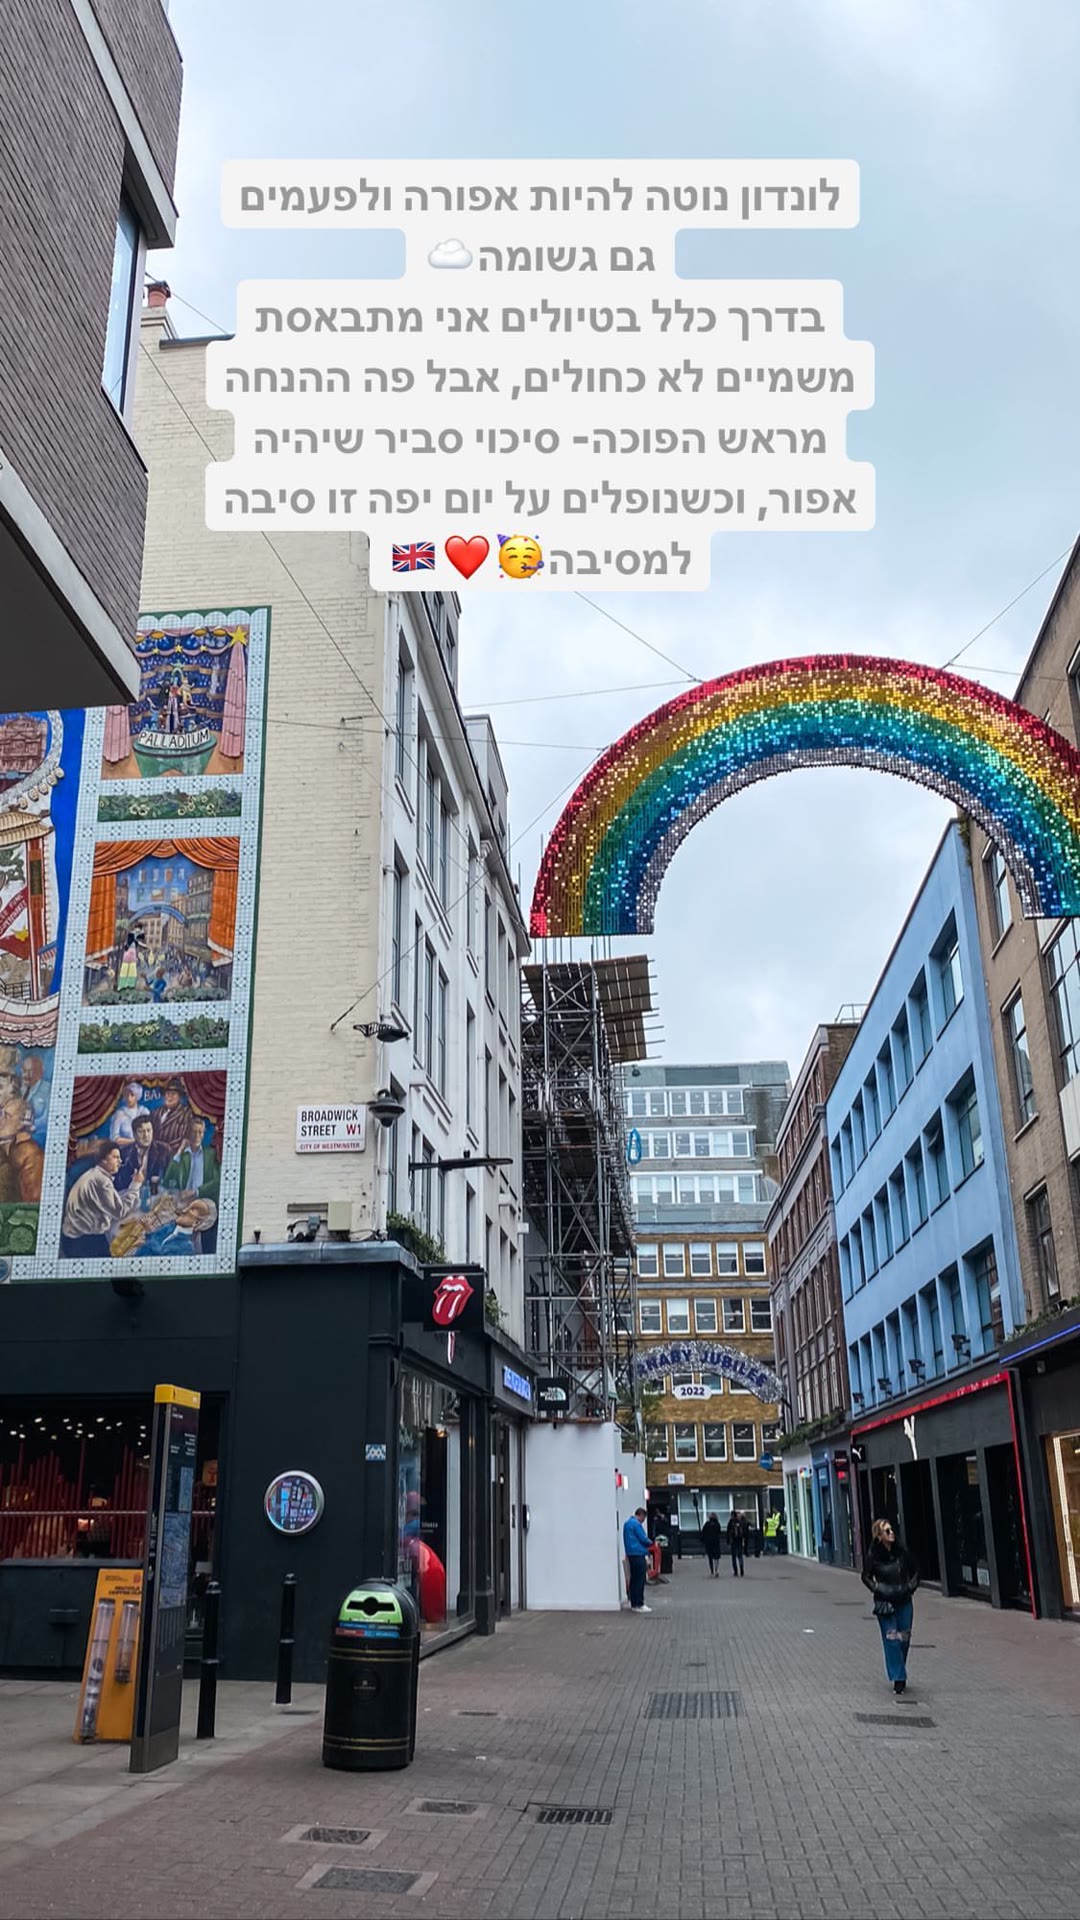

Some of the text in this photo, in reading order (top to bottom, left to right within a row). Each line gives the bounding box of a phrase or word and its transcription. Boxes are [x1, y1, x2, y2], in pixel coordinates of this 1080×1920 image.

[138, 729, 209, 748] PALLADIUM
[301, 1110, 358, 1122] BROADWICK
[301, 1124, 361, 1137] STREET W1
[322, 1142, 360, 1150] WESTMINSTER
[699, 1349, 768, 1387] JUBILEE
[680, 1387, 705, 1396] 2022
